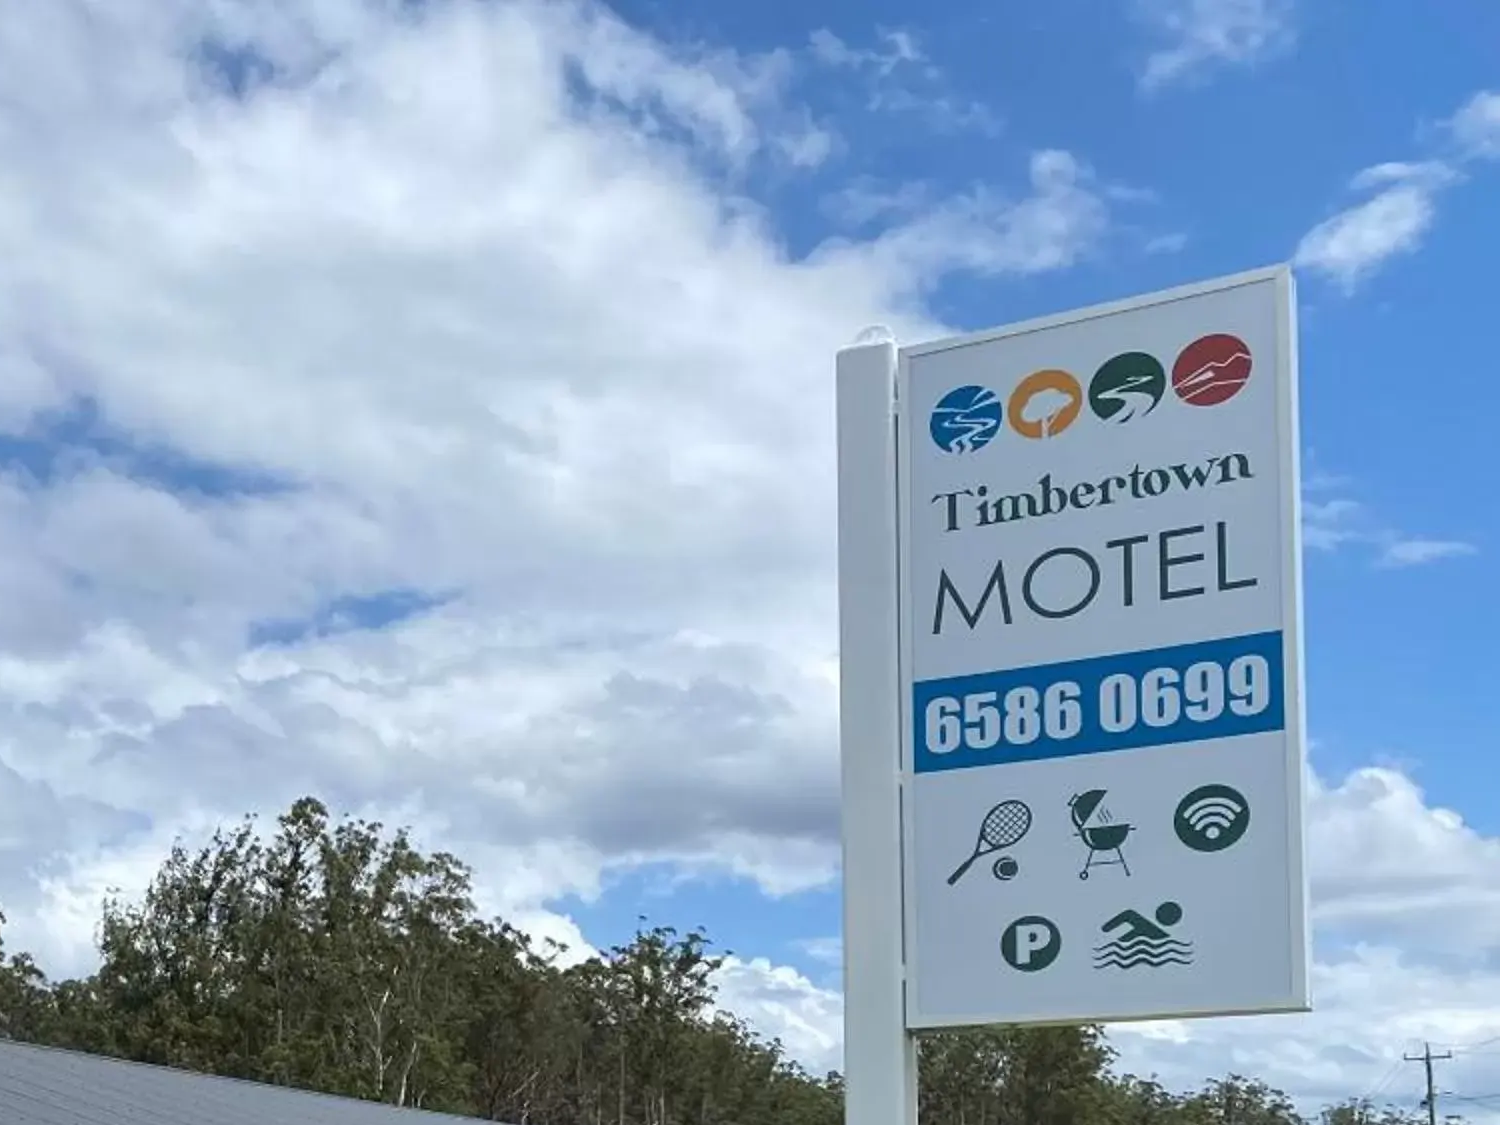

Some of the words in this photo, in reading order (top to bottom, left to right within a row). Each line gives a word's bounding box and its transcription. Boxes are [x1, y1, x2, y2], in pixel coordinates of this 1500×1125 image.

[931, 452, 1254, 532] Timbertown
[931, 521, 1257, 635] MOTEL
[925, 681, 1081, 753] 6586
[1100, 654, 1269, 733] 0699
